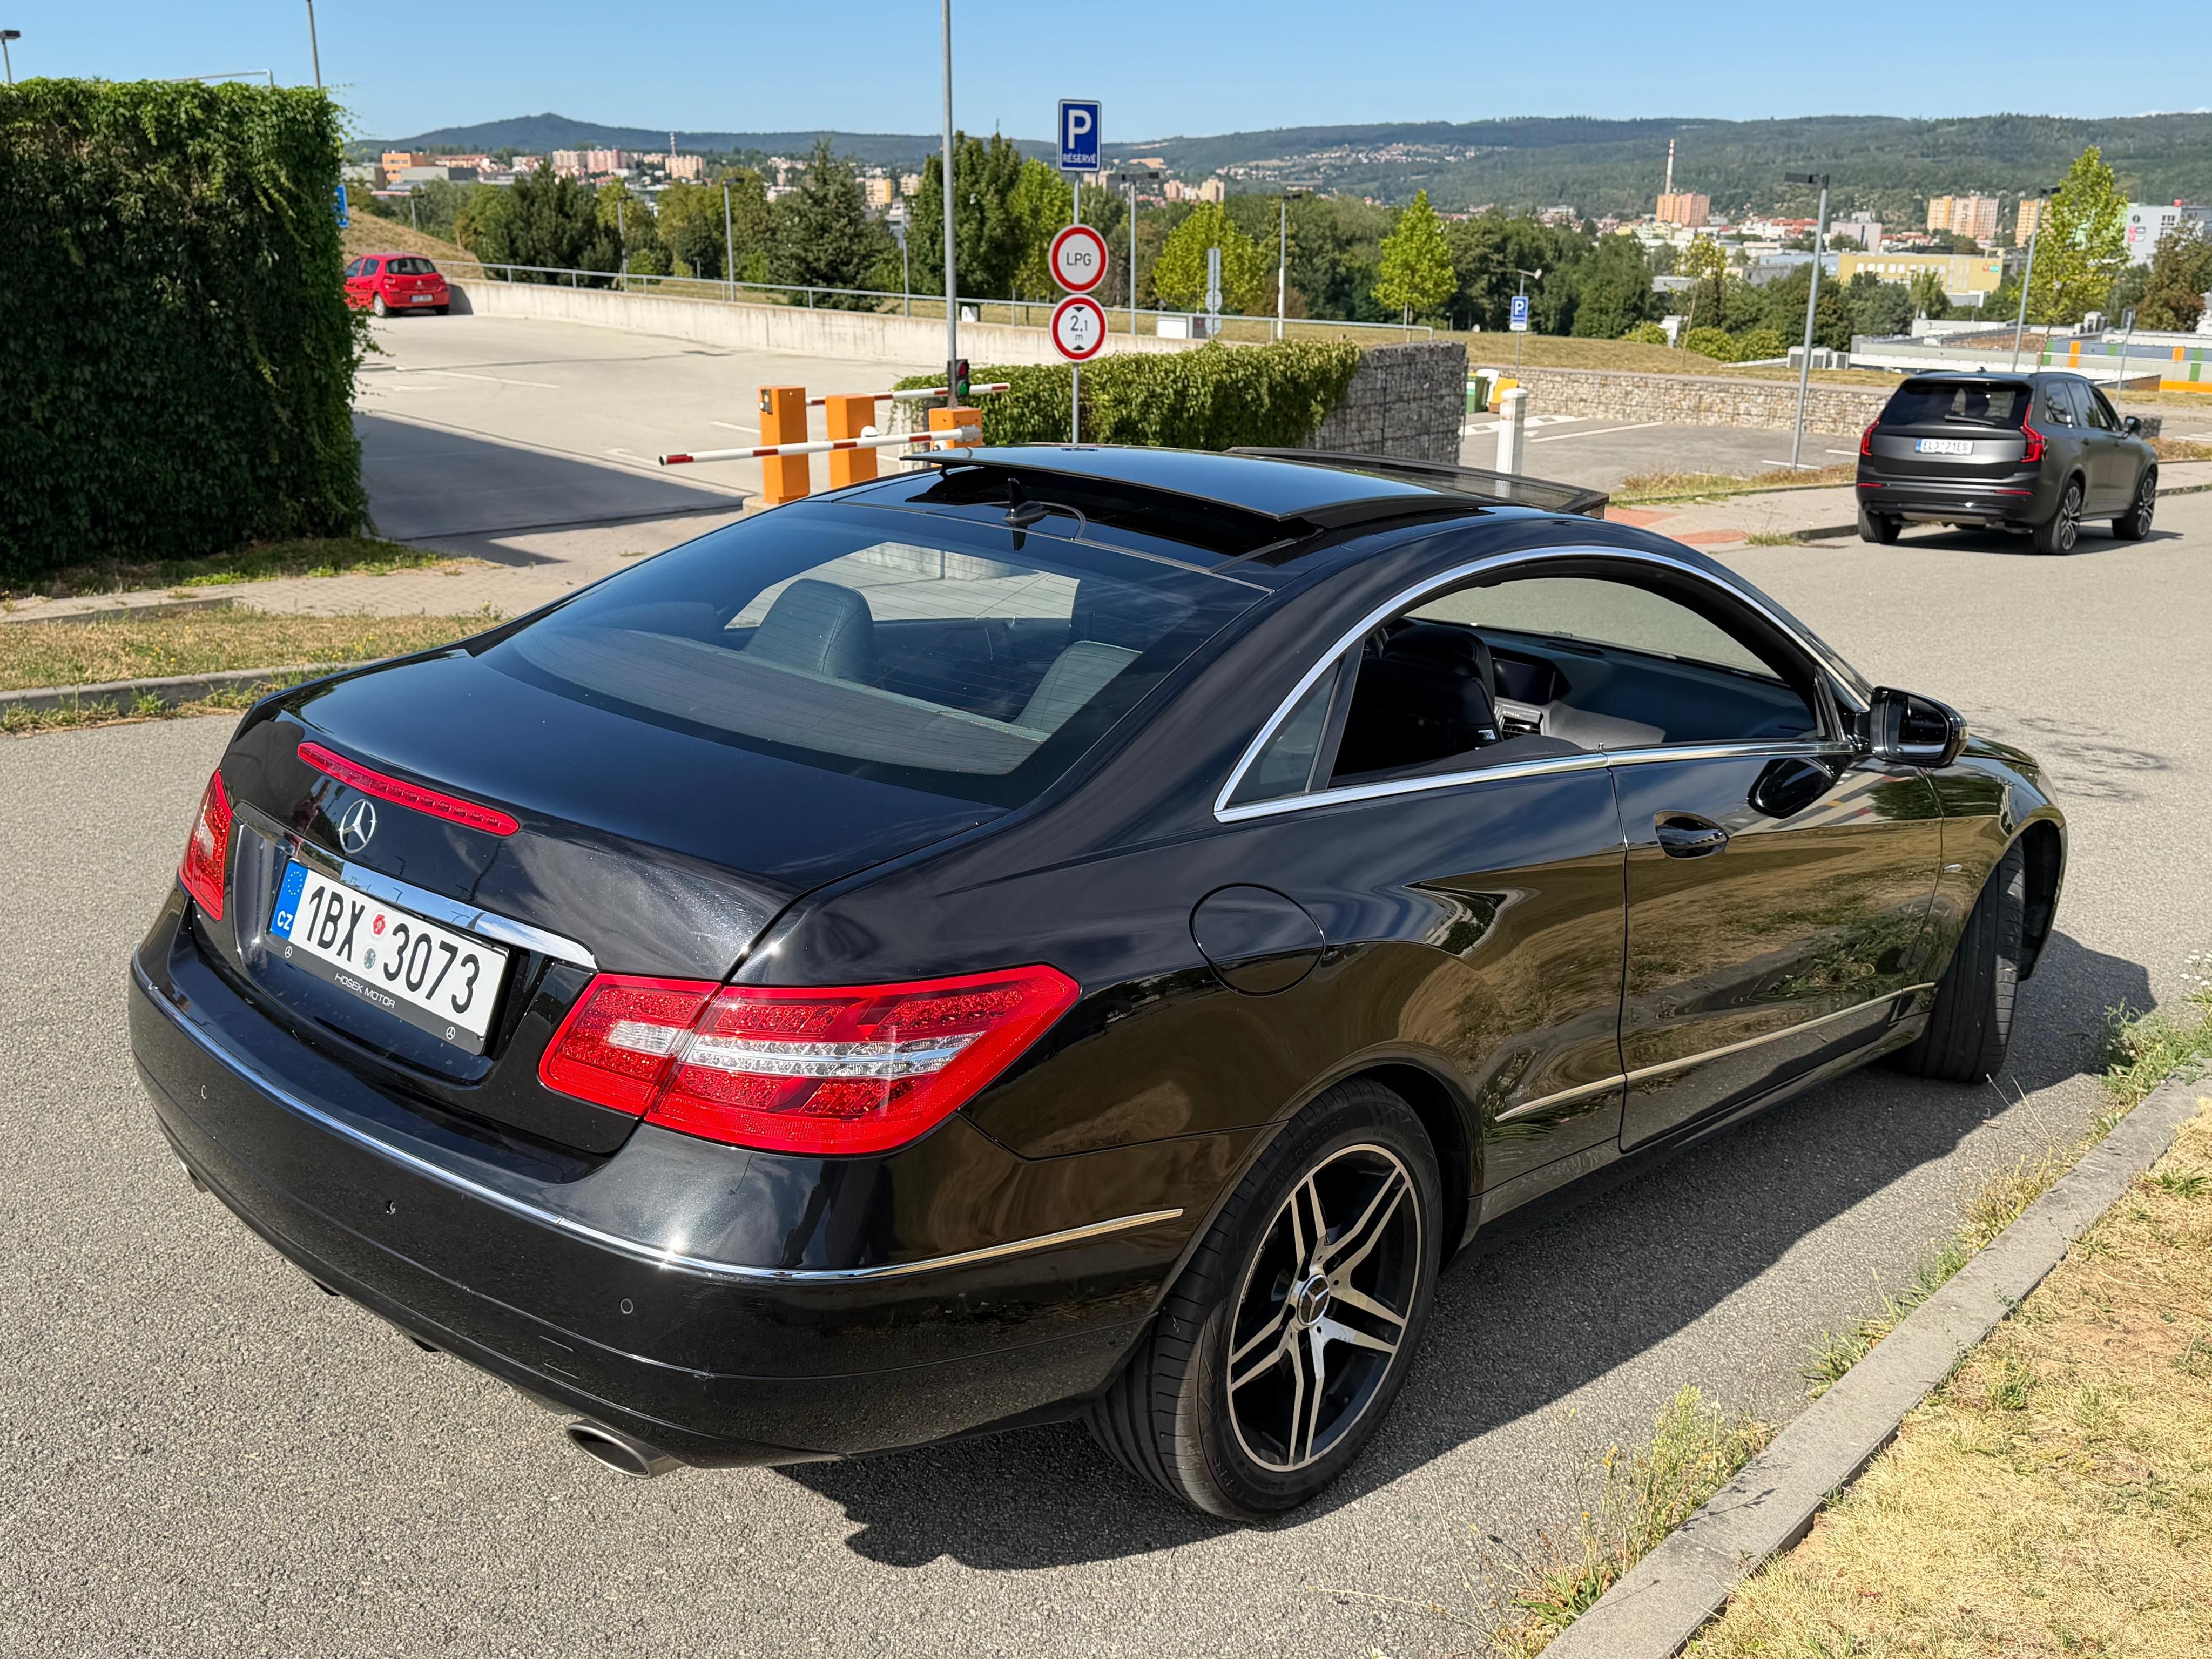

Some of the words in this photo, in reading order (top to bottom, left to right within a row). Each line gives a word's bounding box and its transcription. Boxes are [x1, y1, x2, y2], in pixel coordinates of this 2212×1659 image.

[1068, 109, 1092, 149] P
[1066, 252, 1092, 266] LPG
[1514, 300, 1525, 316] P
[276, 910, 293, 932] CZ
[307, 886, 365, 962] 1BX
[383, 923, 480, 1014] 3073
[364, 987, 396, 1009] MOTOR
